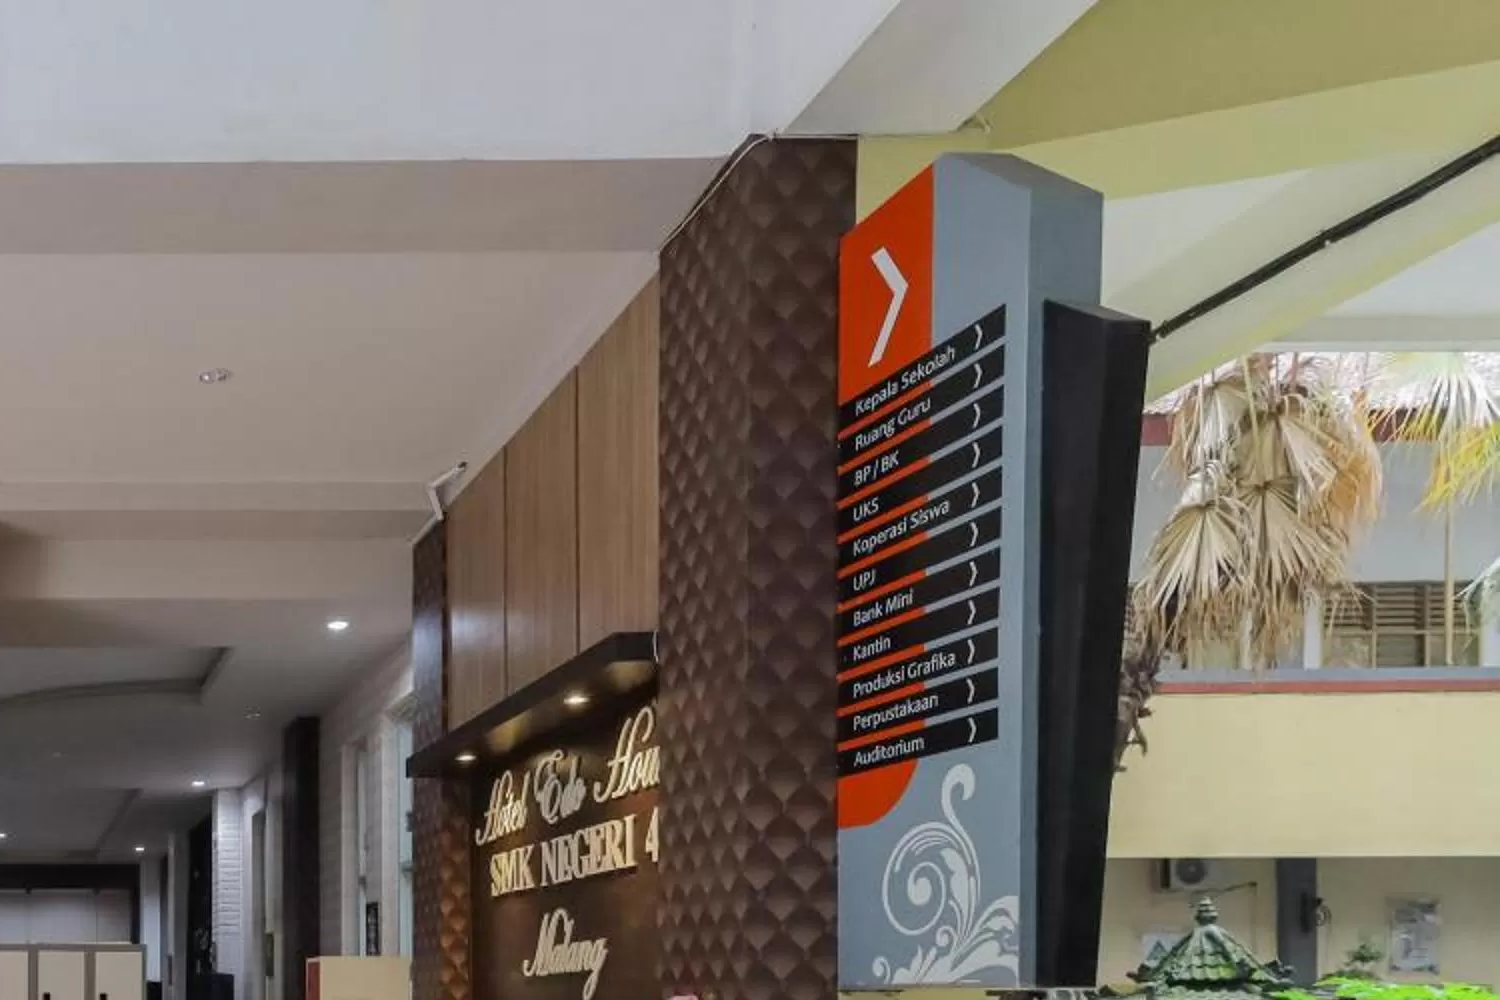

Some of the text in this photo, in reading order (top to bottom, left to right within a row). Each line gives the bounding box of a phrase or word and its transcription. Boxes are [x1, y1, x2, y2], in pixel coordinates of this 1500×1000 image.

[855, 345, 955, 416] Kepala Sekolah
[855, 397, 931, 451] Ruang Guru
[854, 465, 871, 487] BP
[881, 449, 899, 473] BK
[853, 497, 879, 521] UKS
[853, 500, 950, 556] Koperasi Siswa
[853, 568, 877, 591] UPJ
[853, 588, 913, 626] Bank Mini
[853, 636, 891, 661] Kantin
[853, 652, 956, 698] Produksi Grafika
[853, 694, 939, 731] Perpustakaan
[853, 735, 924, 767] Auditorium
[475, 769, 531, 846] Hotel
[490, 806, 660, 897] SMK NEGERI 4
